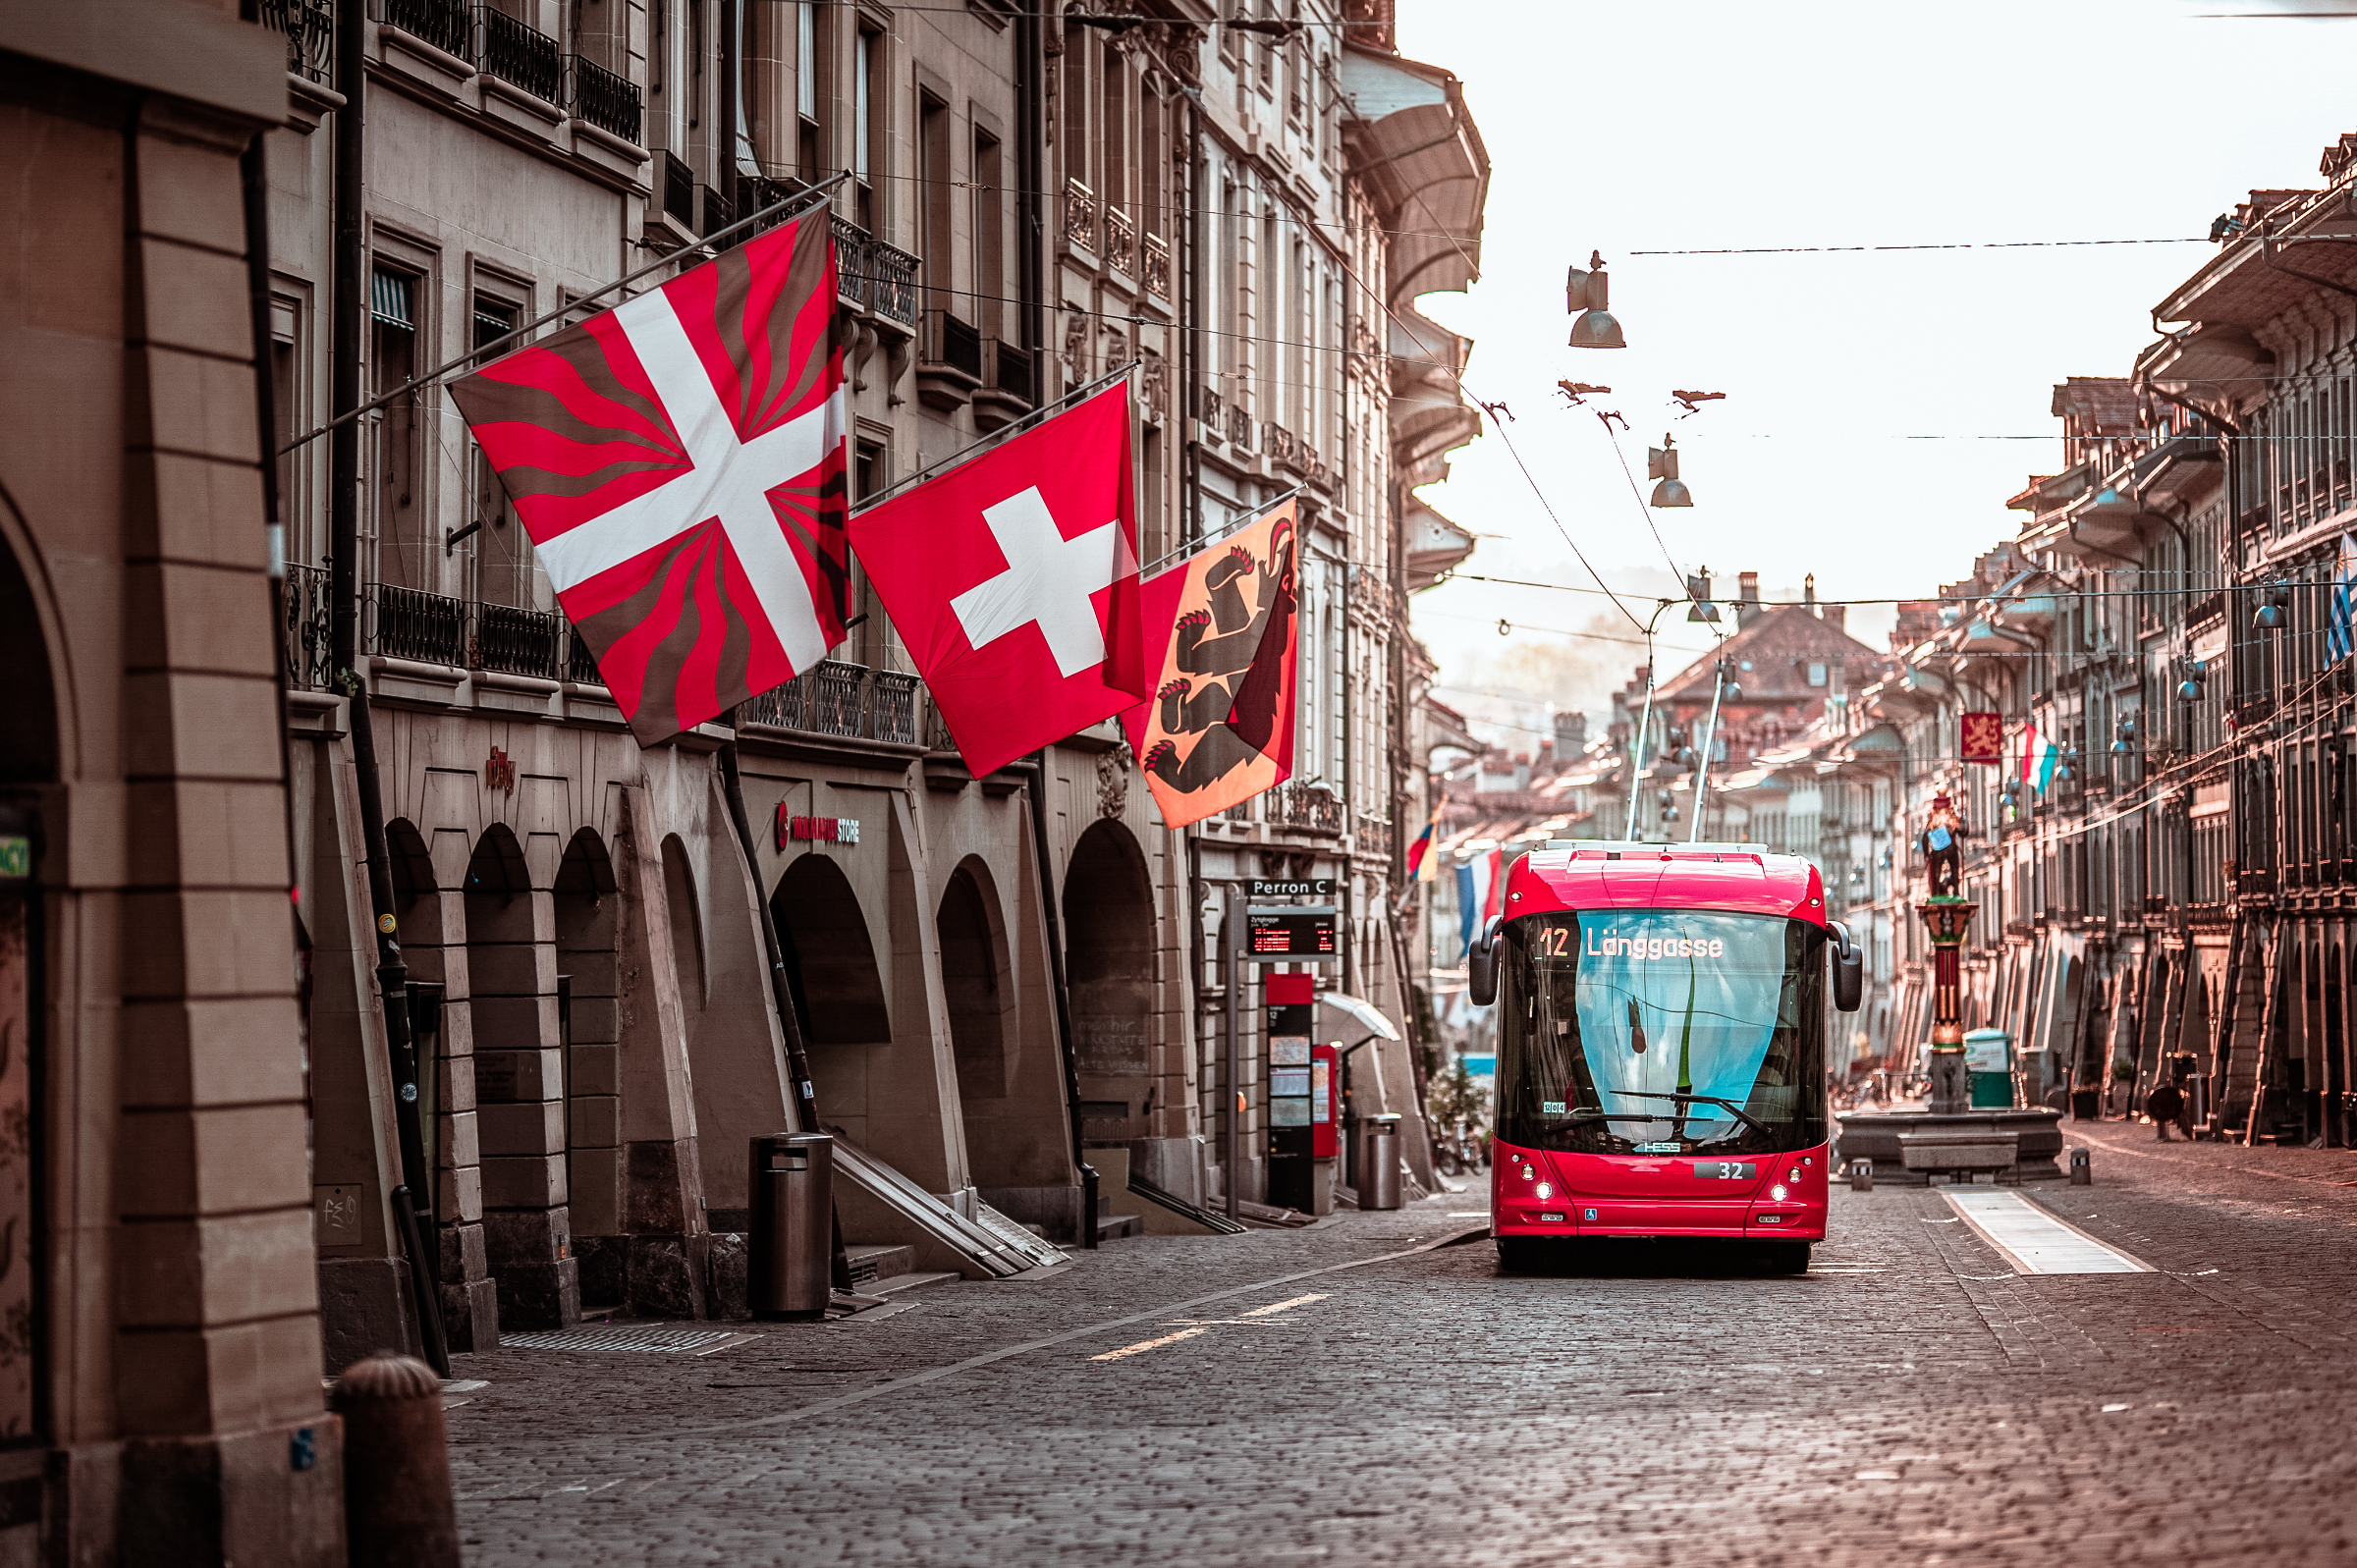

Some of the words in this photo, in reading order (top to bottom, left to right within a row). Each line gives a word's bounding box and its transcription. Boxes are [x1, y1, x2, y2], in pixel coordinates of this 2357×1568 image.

[1254, 881, 1309, 893] Perron
[1316, 881, 1326, 893] C
[1539, 927, 1568, 956] 12
[1587, 927, 1724, 960] Länggasse
[1644, 1142, 1680, 1153] HESS
[1719, 1162, 1743, 1180] 32
